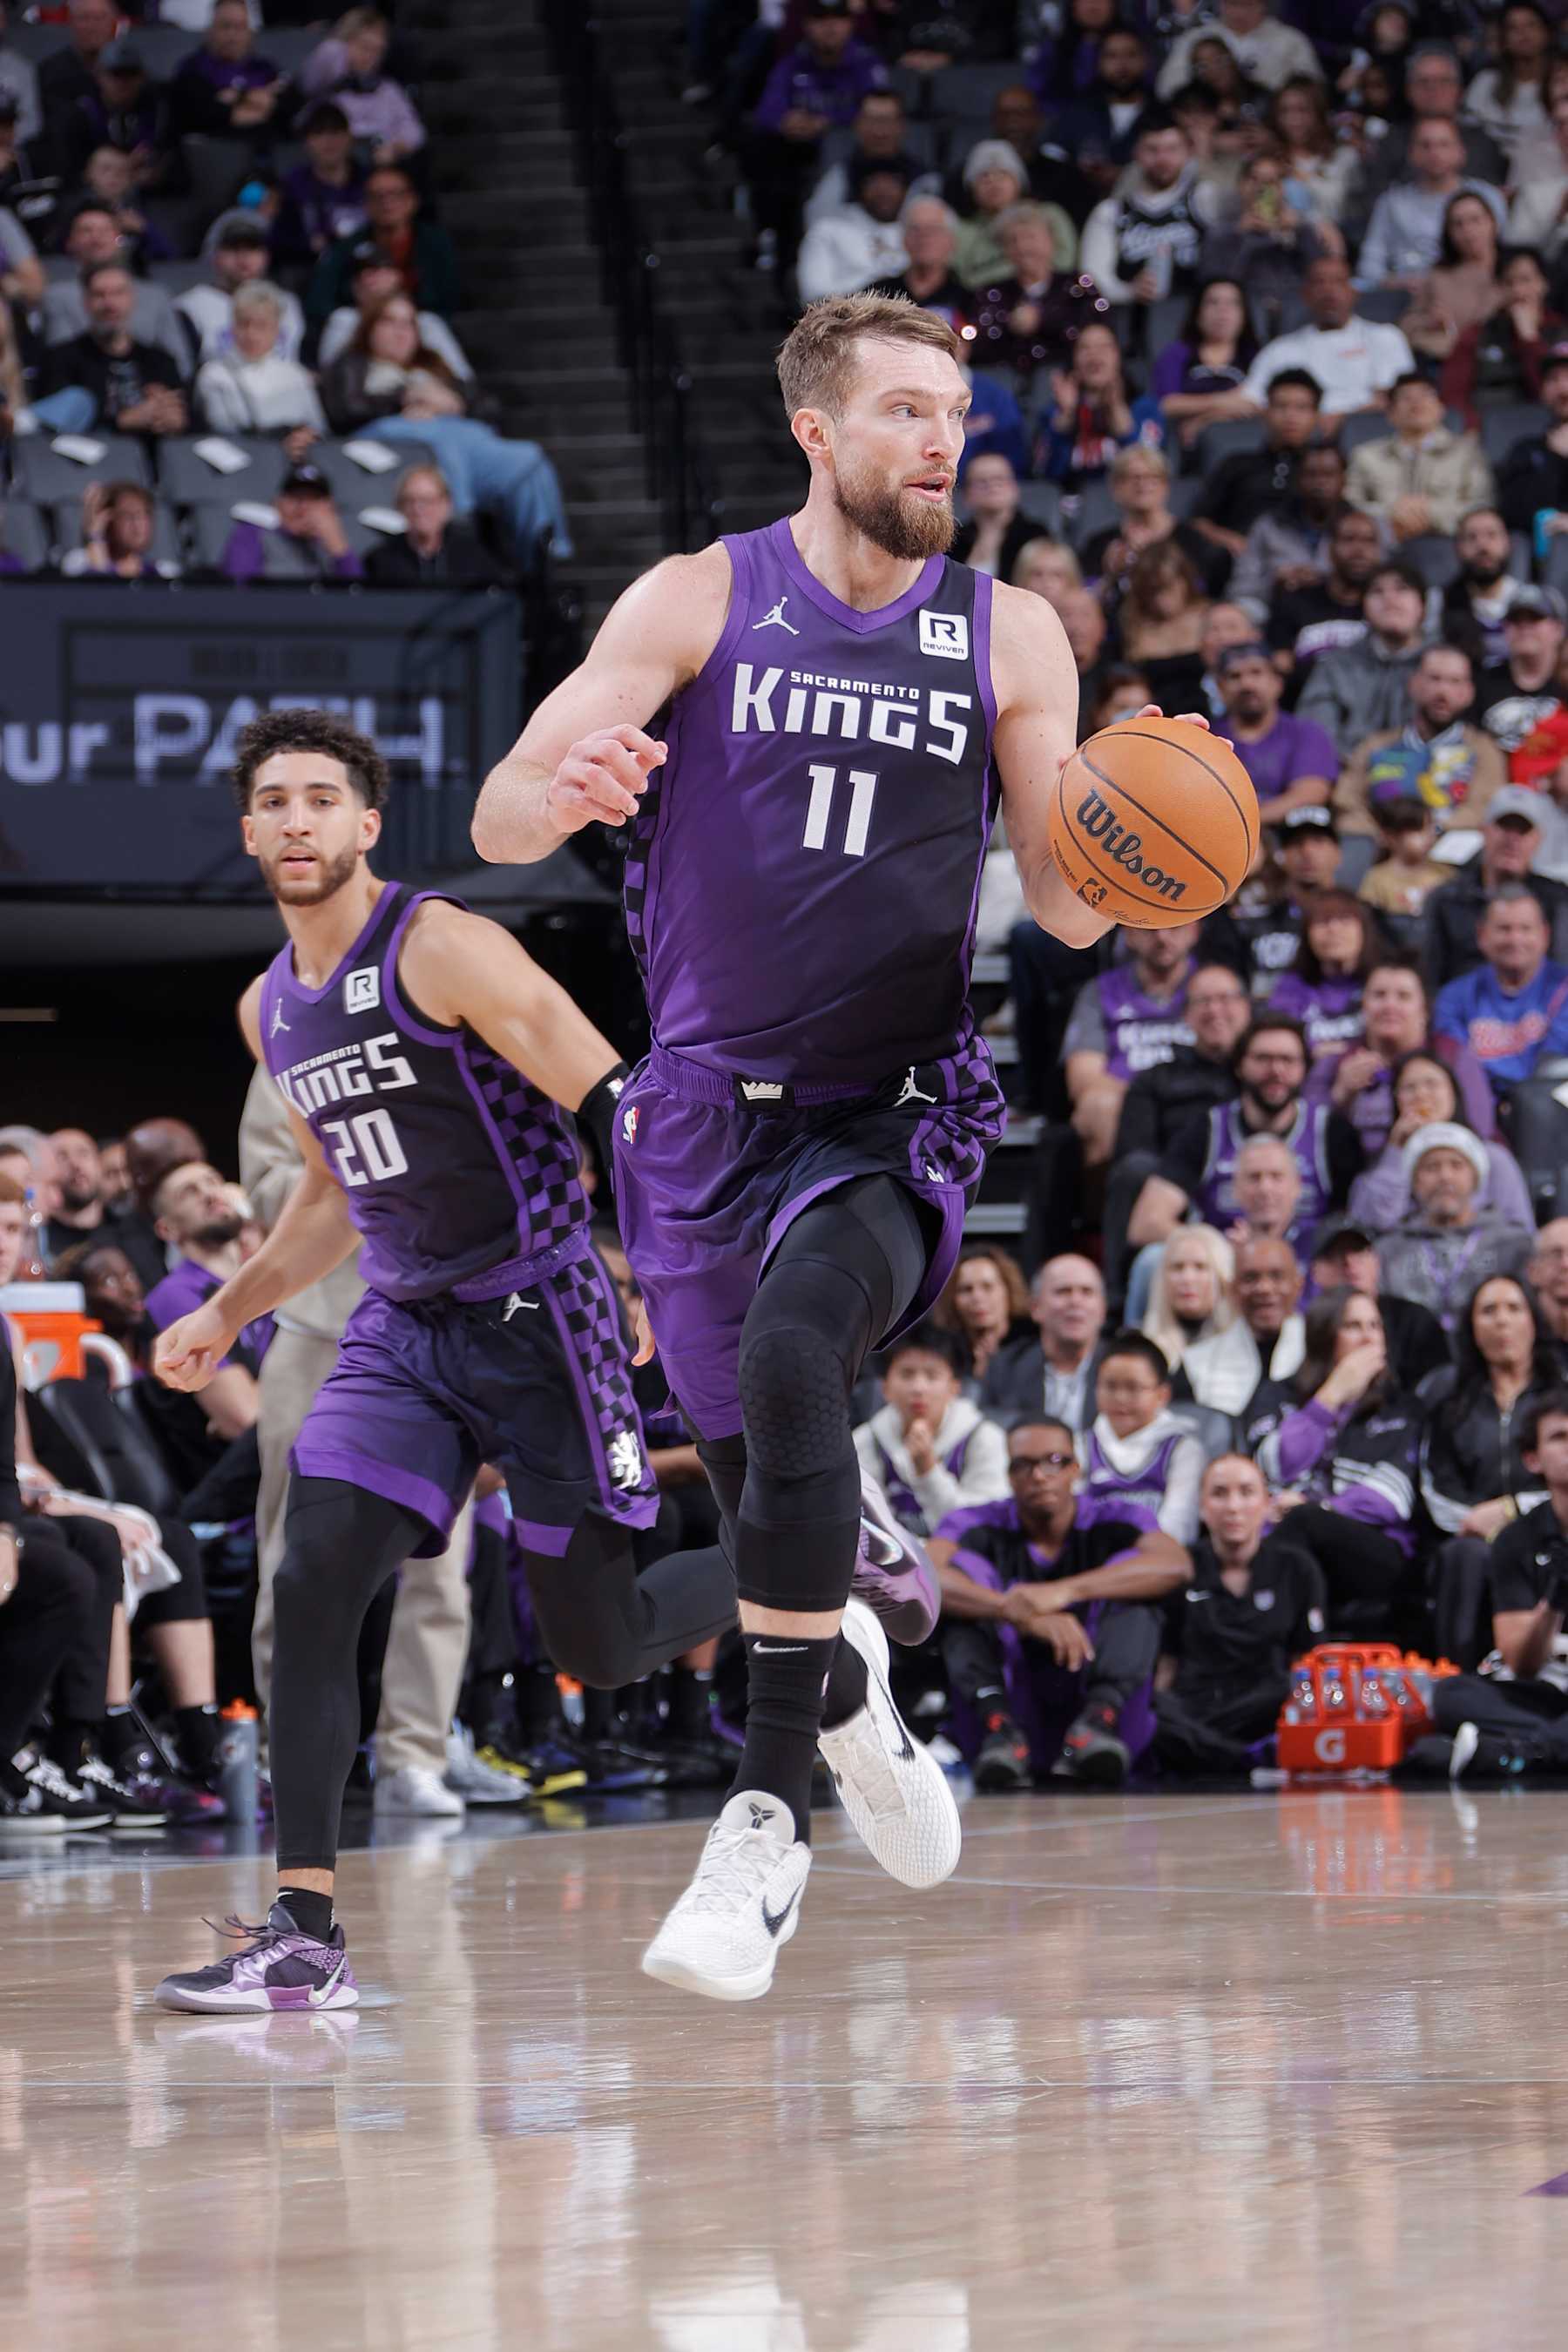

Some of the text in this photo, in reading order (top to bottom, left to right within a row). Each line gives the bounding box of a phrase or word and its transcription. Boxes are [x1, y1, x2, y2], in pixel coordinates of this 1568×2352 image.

[929, 618, 958, 642] R
[732, 663, 972, 766] KINGS
[790, 671, 920, 700] SACRAMENTO
[0, 722, 109, 786] ur
[802, 764, 877, 857] 11
[1077, 788, 1186, 902] Wilson
[289, 1043, 361, 1078] SACRAMENTO
[321, 1108, 409, 1186] 20
[1314, 1728, 1346, 1763] G
